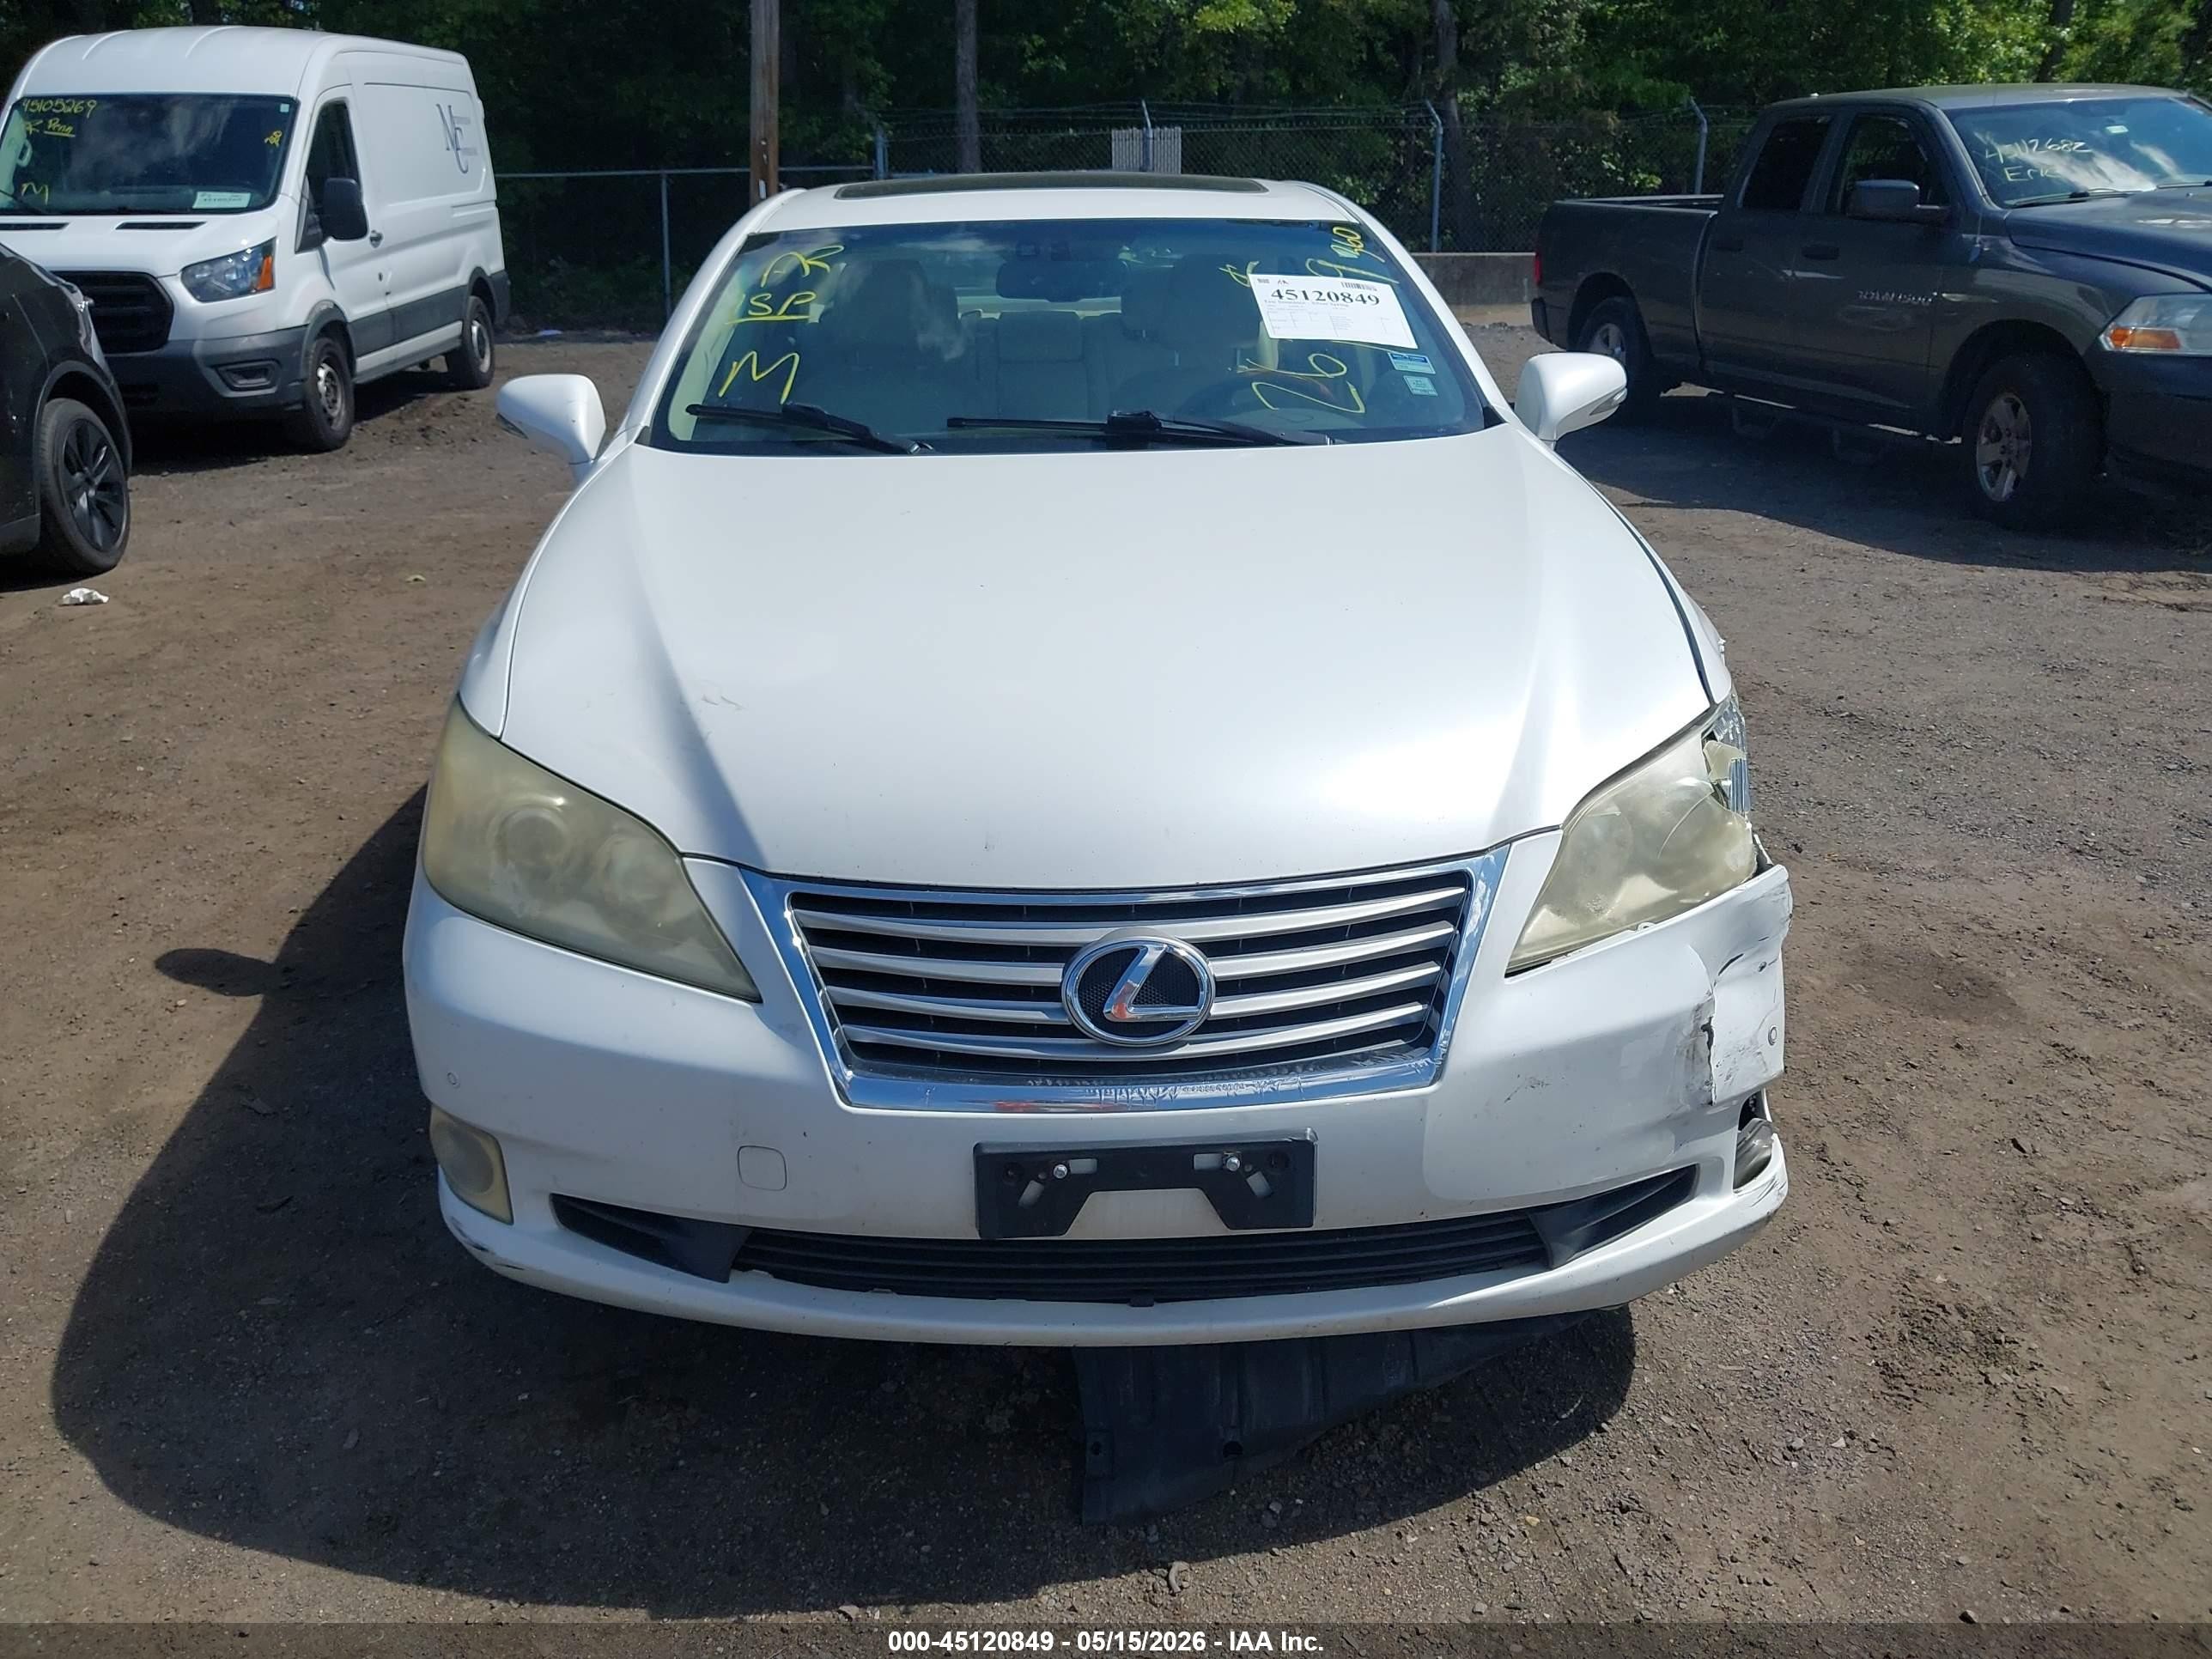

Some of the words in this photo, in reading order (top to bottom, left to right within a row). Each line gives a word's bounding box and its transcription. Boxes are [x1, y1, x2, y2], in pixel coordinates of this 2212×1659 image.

[749, 291, 817, 317] SP
[1271, 289, 1380, 306] 45120849
[718, 350, 800, 404] M
